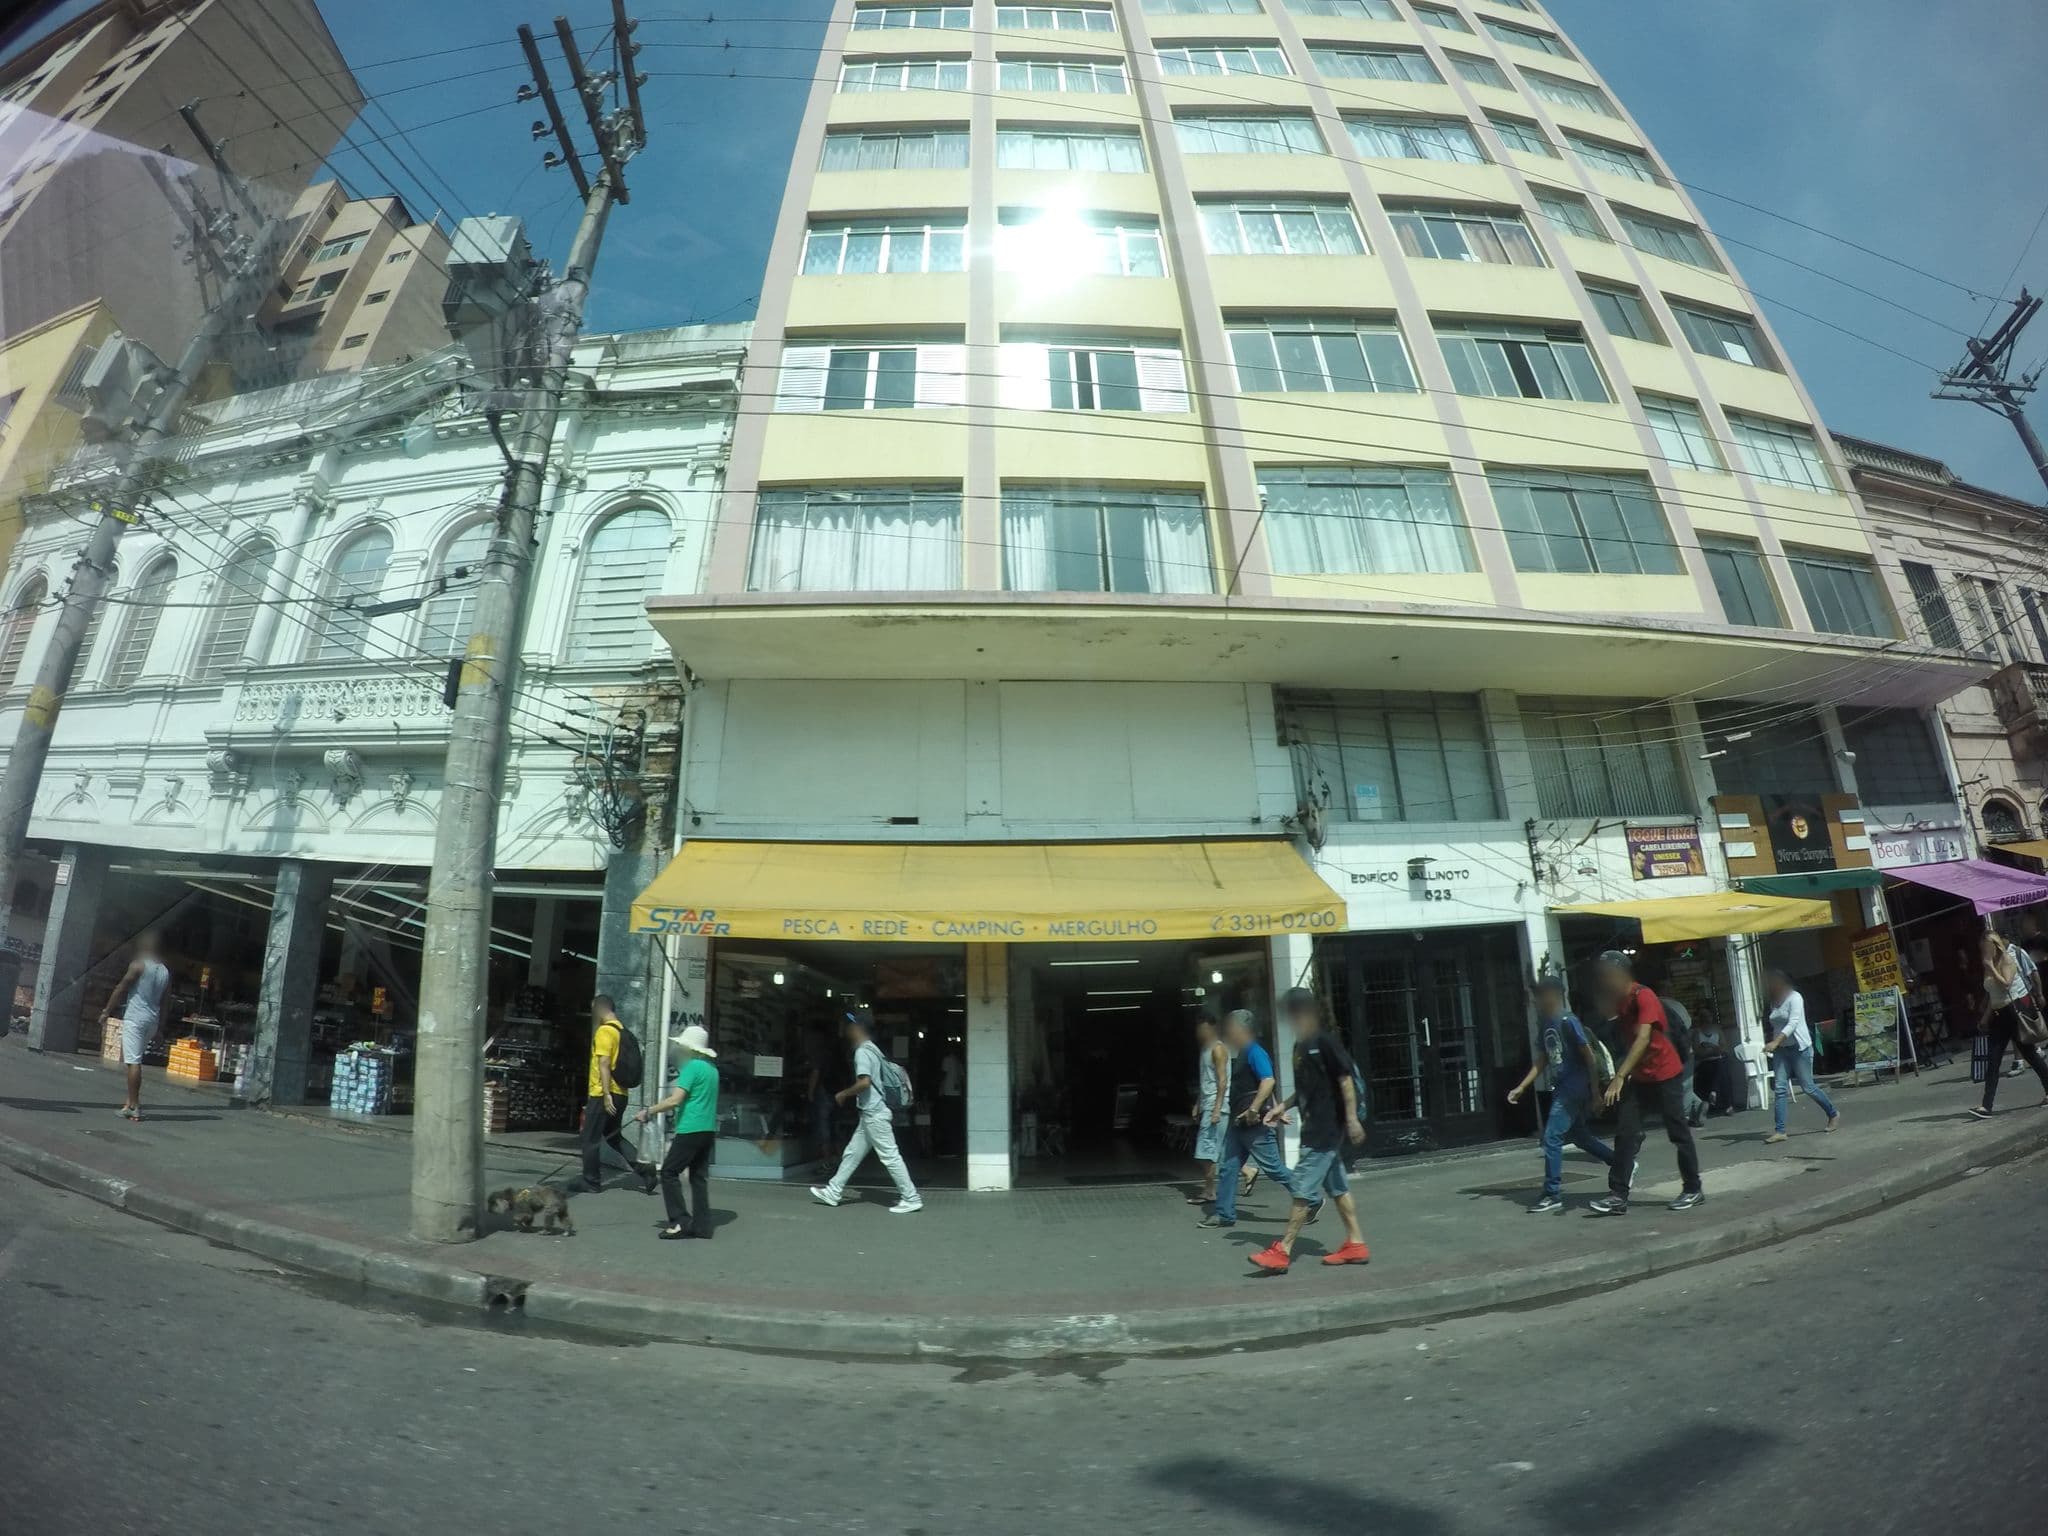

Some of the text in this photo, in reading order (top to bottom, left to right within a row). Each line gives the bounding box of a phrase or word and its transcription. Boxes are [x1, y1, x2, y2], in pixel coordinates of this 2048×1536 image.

[1628, 828, 1665, 842] TOQUE
[1407, 869, 1470, 881] VALLINOTO
[640, 907, 716, 932] STAR
[783, 911, 1336, 936] PESCA REDE CAMPING MERGULHO 3311-0200
